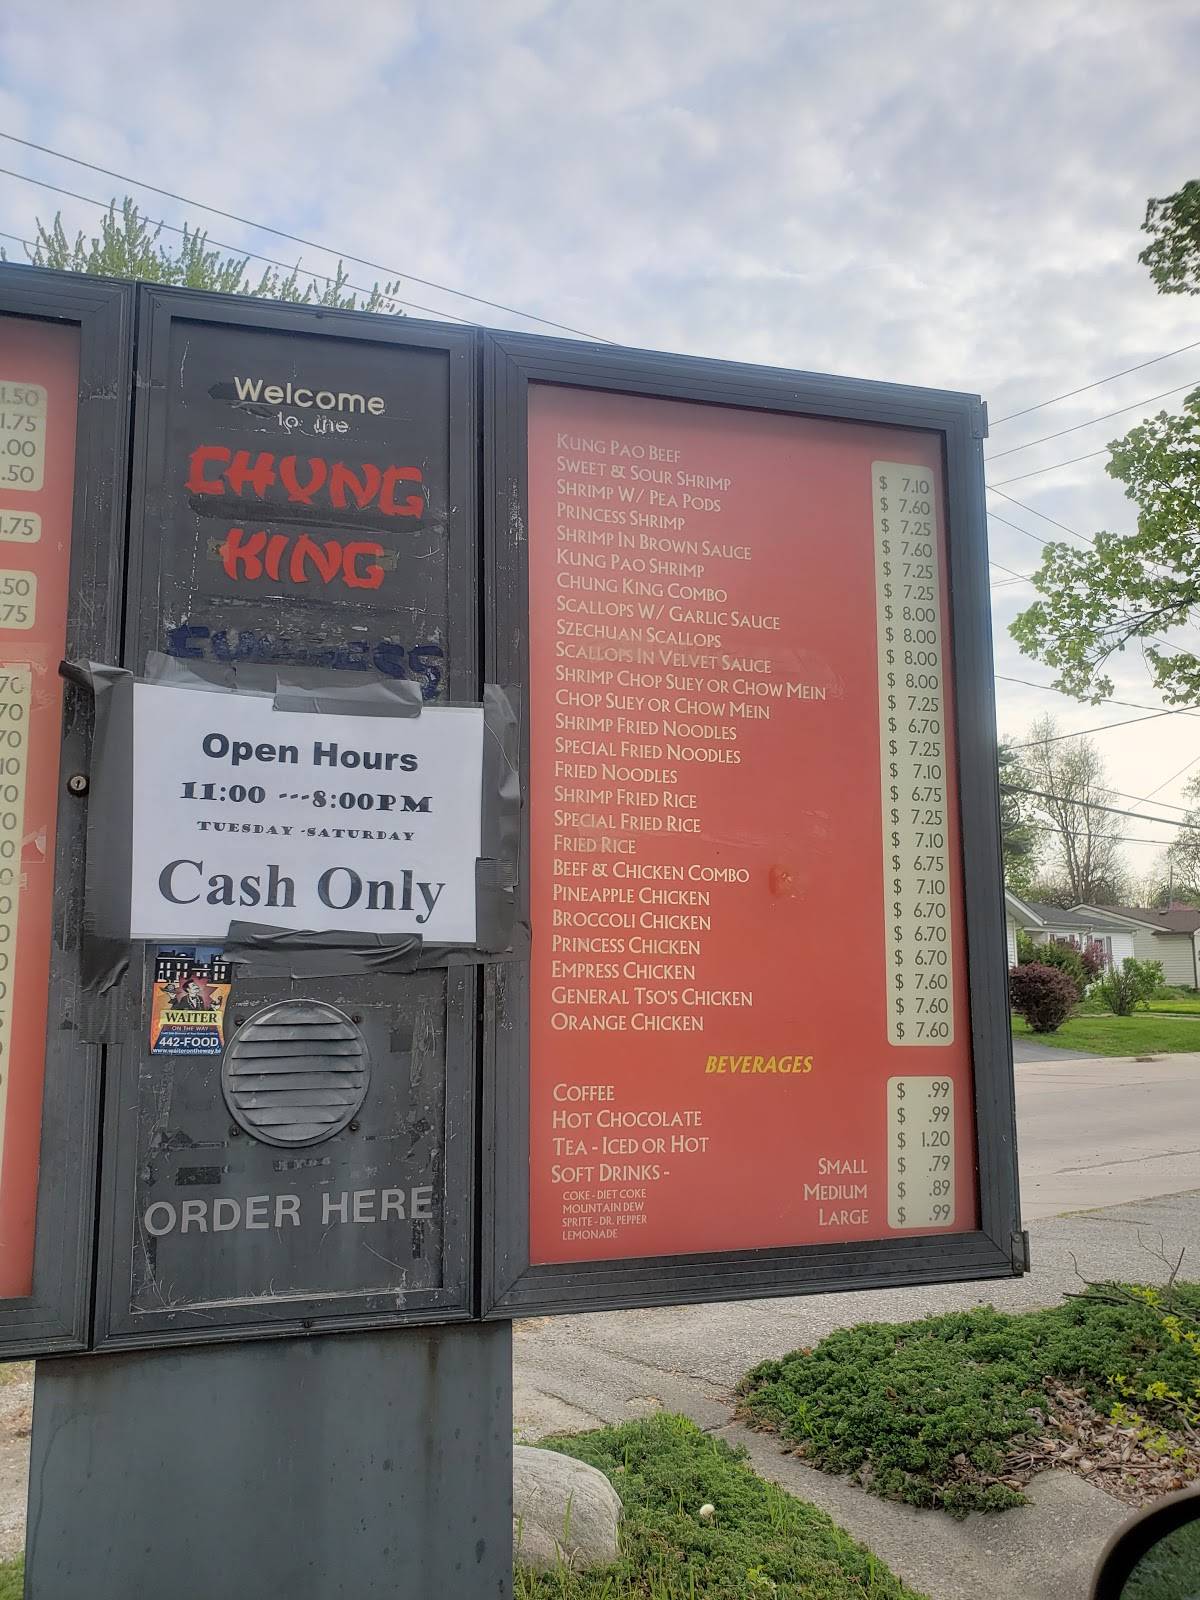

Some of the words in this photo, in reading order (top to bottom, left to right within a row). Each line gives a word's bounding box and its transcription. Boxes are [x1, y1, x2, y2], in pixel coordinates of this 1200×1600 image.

[234, 376, 386, 416] Welcome
[277, 411, 299, 429] to
[557, 432, 605, 454] KUNG
[610, 439, 644, 459] PAO
[649, 445, 680, 463] BEEF
[186, 446, 424, 518] CHUNG
[557, 456, 606, 476] SWEET
[630, 464, 673, 484] SOUR
[676, 470, 731, 491] SHRIMP
[556, 479, 614, 500] SHRIMP
[649, 489, 678, 508] PEA
[682, 493, 721, 512] PODS
[902, 478, 928, 494] 7.10
[557, 501, 626, 524] PRINCESS
[629, 509, 685, 531] SHRIMP
[900, 499, 929, 515] 7.60
[901, 520, 930, 536] 7.25
[556, 525, 614, 546] SHRIMP
[618, 531, 635, 548] IN
[639, 533, 697, 555] BROWN
[702, 540, 751, 560] SAUCE
[901, 541, 932, 557] 7.60
[219, 528, 385, 589] KING
[557, 548, 606, 568] KUNG
[611, 553, 645, 572] PAO
[649, 557, 704, 578] SHRIMP
[903, 563, 932, 579] 7.25
[556, 571, 617, 593] CHUNG
[622, 577, 663, 597] KING
[667, 582, 727, 603] COMBO
[904, 584, 933, 601] 7.25
[556, 596, 633, 617] SCALLOPS
[668, 605, 728, 626] GARLIC
[729, 610, 780, 631] SAUCE
[902, 606, 935, 623] 8.00
[556, 618, 642, 642] SZECHUAN
[646, 626, 722, 648] SCALLOPS
[903, 628, 936, 644] 8.00
[555, 641, 633, 663] SCALLOPS
[637, 648, 654, 665] IN
[658, 649, 718, 669] VELVET
[721, 654, 771, 674] SAUCE
[904, 650, 937, 666] 8.00
[555, 665, 613, 685] SHRIMP
[617, 669, 662, 688] CHOP
[665, 673, 704, 692] SUEY
[706, 678, 729, 693] OR
[732, 678, 783, 697] CHOW
[786, 682, 825, 700] MEIN
[905, 673, 938, 689] 8.00
[555, 690, 602, 707] CHOP
[605, 693, 644, 710] SUEY
[647, 697, 671, 713] OR
[674, 697, 725, 716] CHOW
[729, 701, 769, 719] MEIN
[907, 695, 939, 712] 7.25
[555, 713, 613, 732] SHRIMP
[617, 717, 658, 735] FRIED
[663, 720, 737, 740] NOODLES
[908, 718, 940, 734] 6.70
[202, 732, 299, 765] Open
[313, 741, 419, 772] Hours
[555, 737, 616, 756] SPECIAL
[620, 741, 662, 759] FRIED
[666, 743, 741, 764] NOODLES
[909, 740, 940, 757] 7.25
[555, 760, 597, 779] FRIED
[601, 763, 677, 784] NOODLES
[913, 763, 941, 779] 7.10
[180, 781, 266, 804] 11:00
[554, 785, 613, 804] SHRIMP
[617, 788, 659, 806] FRIED
[663, 791, 697, 808] RICE
[911, 786, 942, 802] 6.75
[554, 810, 616, 828] SPECIAL
[620, 812, 662, 831] FRIED
[665, 815, 701, 832] RICE
[911, 809, 942, 825] 7.25
[197, 821, 294, 836] TUESDAY
[554, 834, 596, 852] FRIED
[601, 836, 636, 854] RICE
[915, 832, 943, 848] 7.10
[553, 860, 588, 876] BEEF
[612, 861, 683, 880] CHICKEN
[687, 864, 749, 882] COMBO
[913, 855, 943, 871] 6.75
[158, 859, 297, 908] Cash
[317, 866, 446, 923] Only
[553, 885, 634, 903] PINEAPPLE
[638, 886, 709, 905] CHICKEN
[916, 879, 945, 895] 7.10
[913, 902, 945, 918] 6.70
[552, 910, 635, 928] BROCCOLI
[639, 911, 711, 930] CHICKEN
[914, 926, 946, 941] 6.70
[552, 935, 625, 953] PRINCESS
[628, 936, 700, 954] CHICKEN
[914, 949, 947, 965] 6.70
[552, 961, 619, 978] EMPRESS
[622, 961, 695, 980] CHICKEN
[915, 973, 947, 989] 7.60
[551, 987, 629, 1005] GENERAL
[633, 987, 678, 1005] TSO'S
[681, 987, 752, 1006] CHICKEN
[915, 997, 948, 1013] 7.60
[165, 1012, 217, 1023] WAITER
[551, 1012, 627, 1031] ORANGE
[630, 1011, 703, 1032] CHICKEN
[916, 1021, 949, 1038] 7.60
[159, 1037, 219, 1047] 442-FOOD
[704, 1053, 813, 1075] BEVERAGES
[553, 1082, 614, 1102] COFFEE
[927, 1081, 949, 1097] .99
[552, 1109, 592, 1129] HOT
[596, 1106, 702, 1130] CHOCOLATE
[928, 1106, 949, 1122] .99
[552, 1137, 587, 1156] TEA
[602, 1135, 638, 1155] ICED
[641, 1137, 666, 1154] OR
[671, 1133, 709, 1153] HOT
[922, 1130, 950, 1147] 1.20
[551, 1162, 595, 1184] SOFT
[599, 1160, 660, 1182] DRINKS
[818, 1156, 867, 1175] SMALL
[928, 1154, 950, 1171] .79
[562, 1190, 590, 1201] COKE
[597, 1188, 618, 1199] DIET
[619, 1187, 646, 1199] COKE
[803, 1180, 867, 1202] MEDIUM
[928, 1179, 950, 1196] .89
[144, 1194, 301, 1236] ORDER
[322, 1185, 433, 1225] HERE
[562, 1201, 621, 1215] MOUNTAIN
[818, 1205, 868, 1226] LARGE
[928, 1204, 950, 1220] .99
[562, 1216, 592, 1228] SPRITE
[599, 1215, 614, 1226] DR.
[616, 1213, 646, 1225] PEPPER
[562, 1227, 617, 1241] LEMONADE
